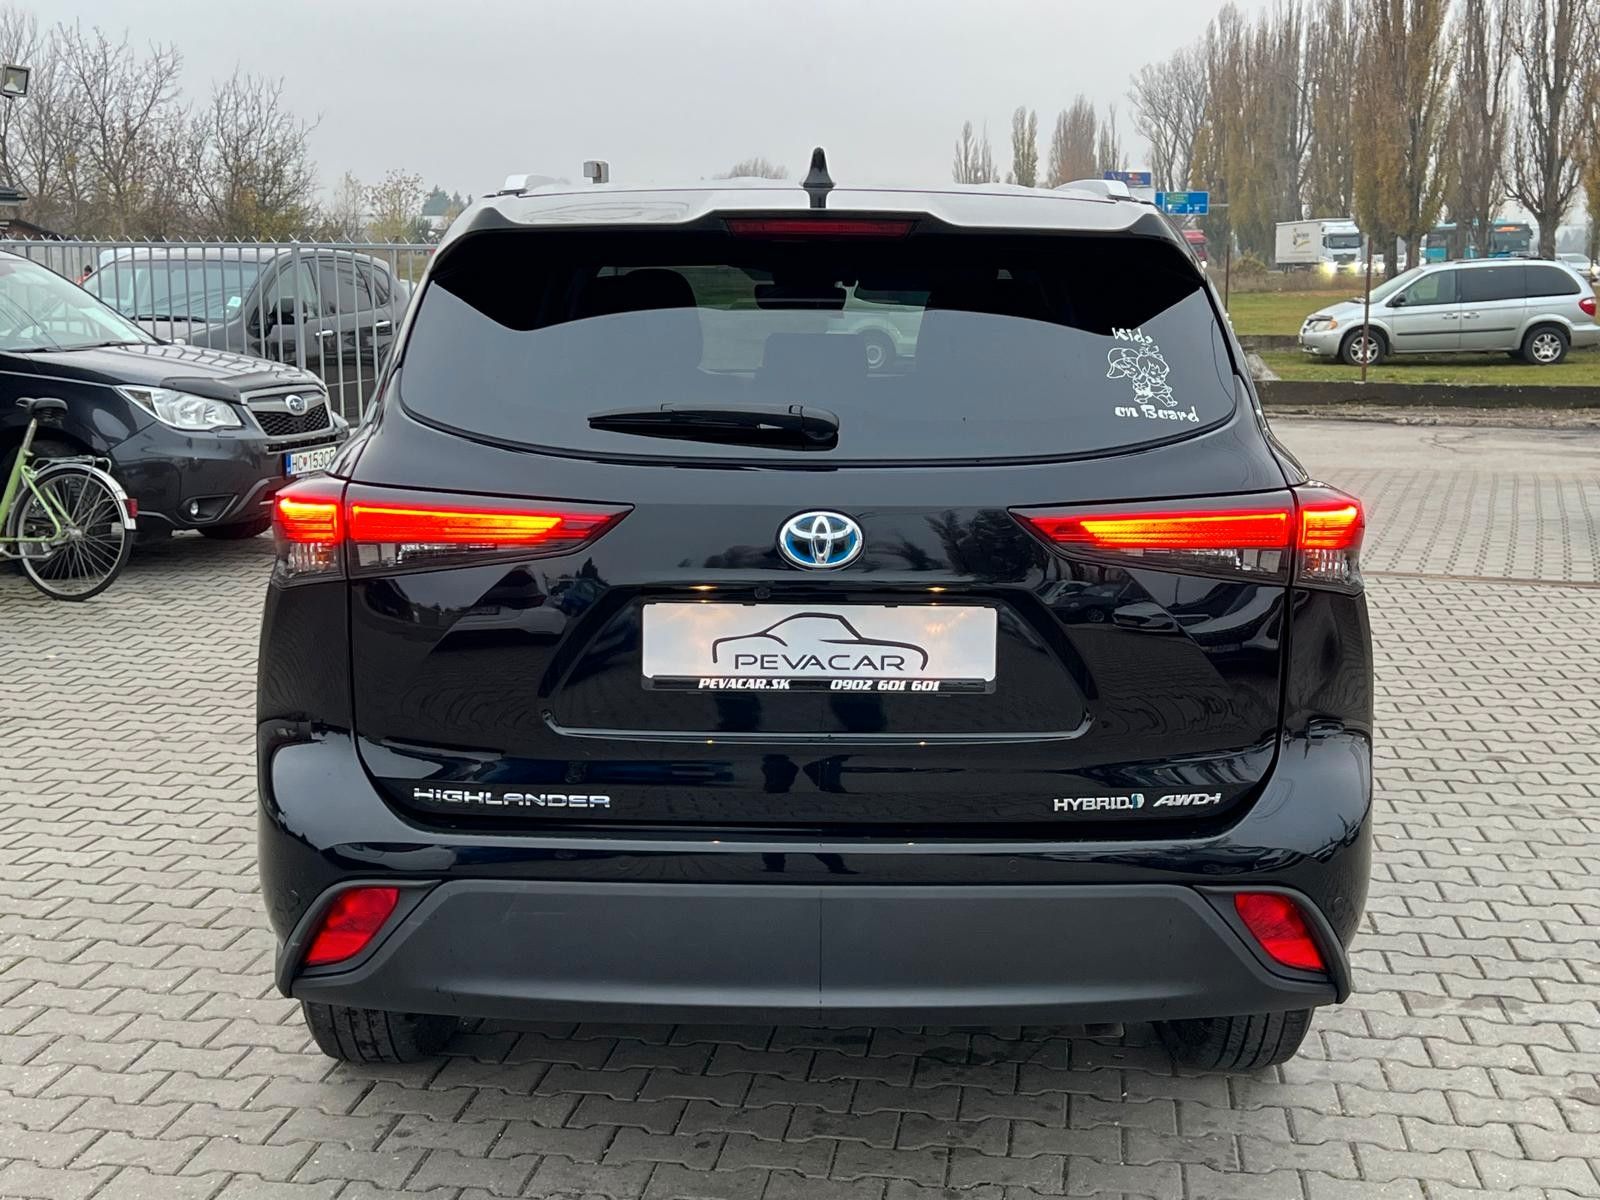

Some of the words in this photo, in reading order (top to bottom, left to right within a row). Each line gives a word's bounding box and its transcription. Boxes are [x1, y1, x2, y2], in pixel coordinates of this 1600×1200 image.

[1112, 327, 1153, 343] Kids
[1115, 406, 1138, 417] on
[1140, 404, 1200, 422] Board
[734, 654, 905, 671] PEVACAR
[698, 678, 790, 690] PEVACAR.SK
[830, 679, 872, 691] 0902
[877, 680, 906, 691] 601
[911, 680, 939, 692] 601
[413, 787, 611, 808] HIGHLANDER
[1053, 796, 1133, 812] HYBRID
